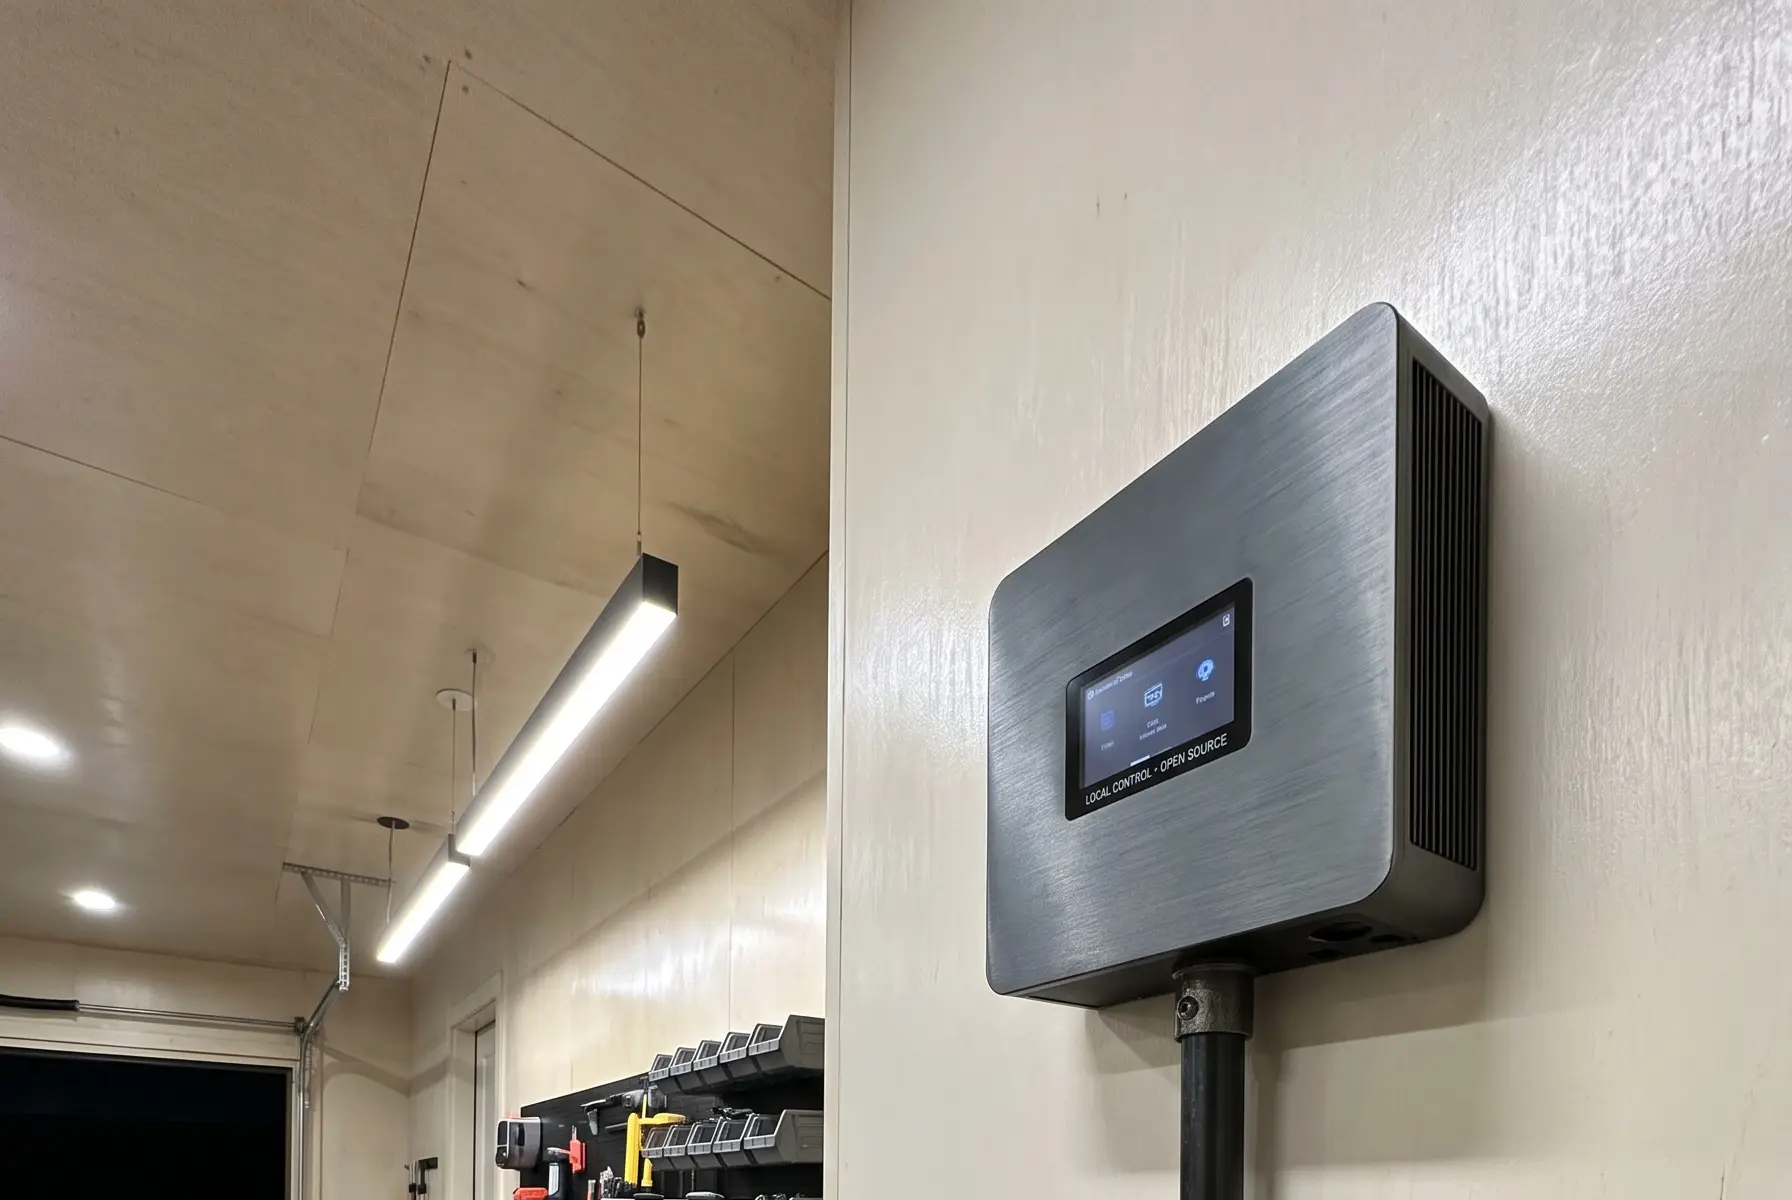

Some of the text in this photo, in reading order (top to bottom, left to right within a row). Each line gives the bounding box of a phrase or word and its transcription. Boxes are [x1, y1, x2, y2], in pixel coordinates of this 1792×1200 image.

[1086, 787, 1111, 806] LOCAL
[1112, 768, 1152, 793] CONTROL
[1160, 751, 1185, 773] OPEN
[1187, 733, 1228, 761] SOURCE
